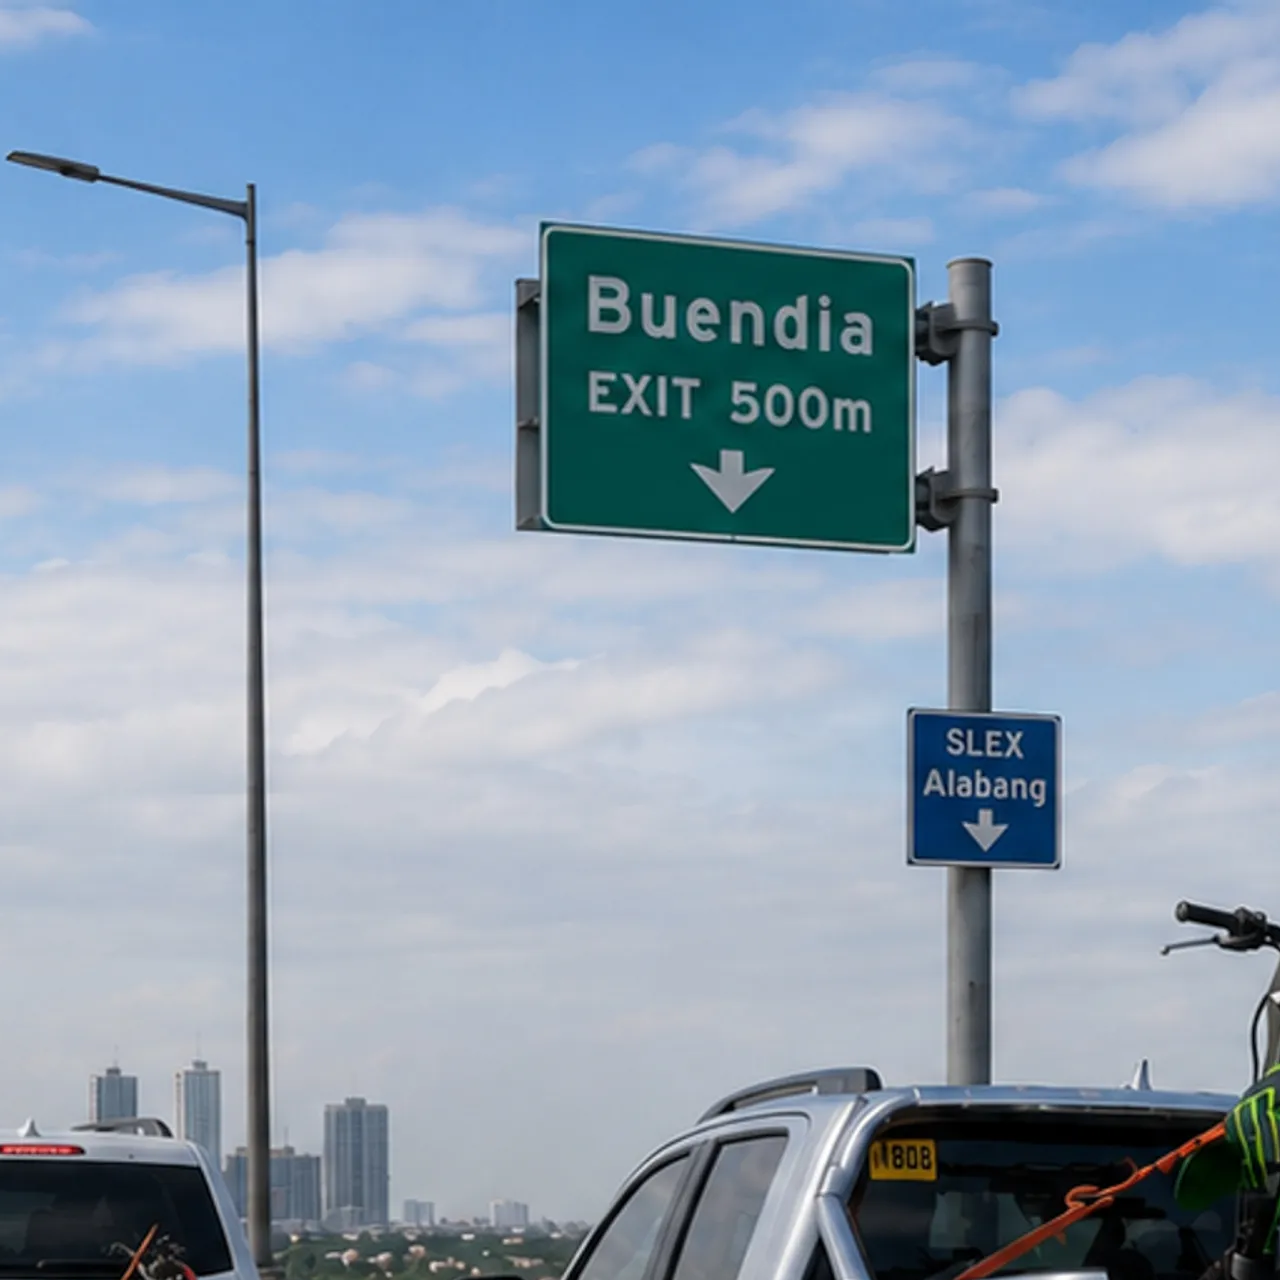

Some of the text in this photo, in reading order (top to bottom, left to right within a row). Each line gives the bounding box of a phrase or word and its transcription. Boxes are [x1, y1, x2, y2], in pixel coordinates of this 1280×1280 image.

[588, 274, 873, 356] Buendia
[588, 370, 872, 433] EXIT 500m
[946, 727, 1024, 759] SLEX
[923, 768, 1047, 808] Alabang
